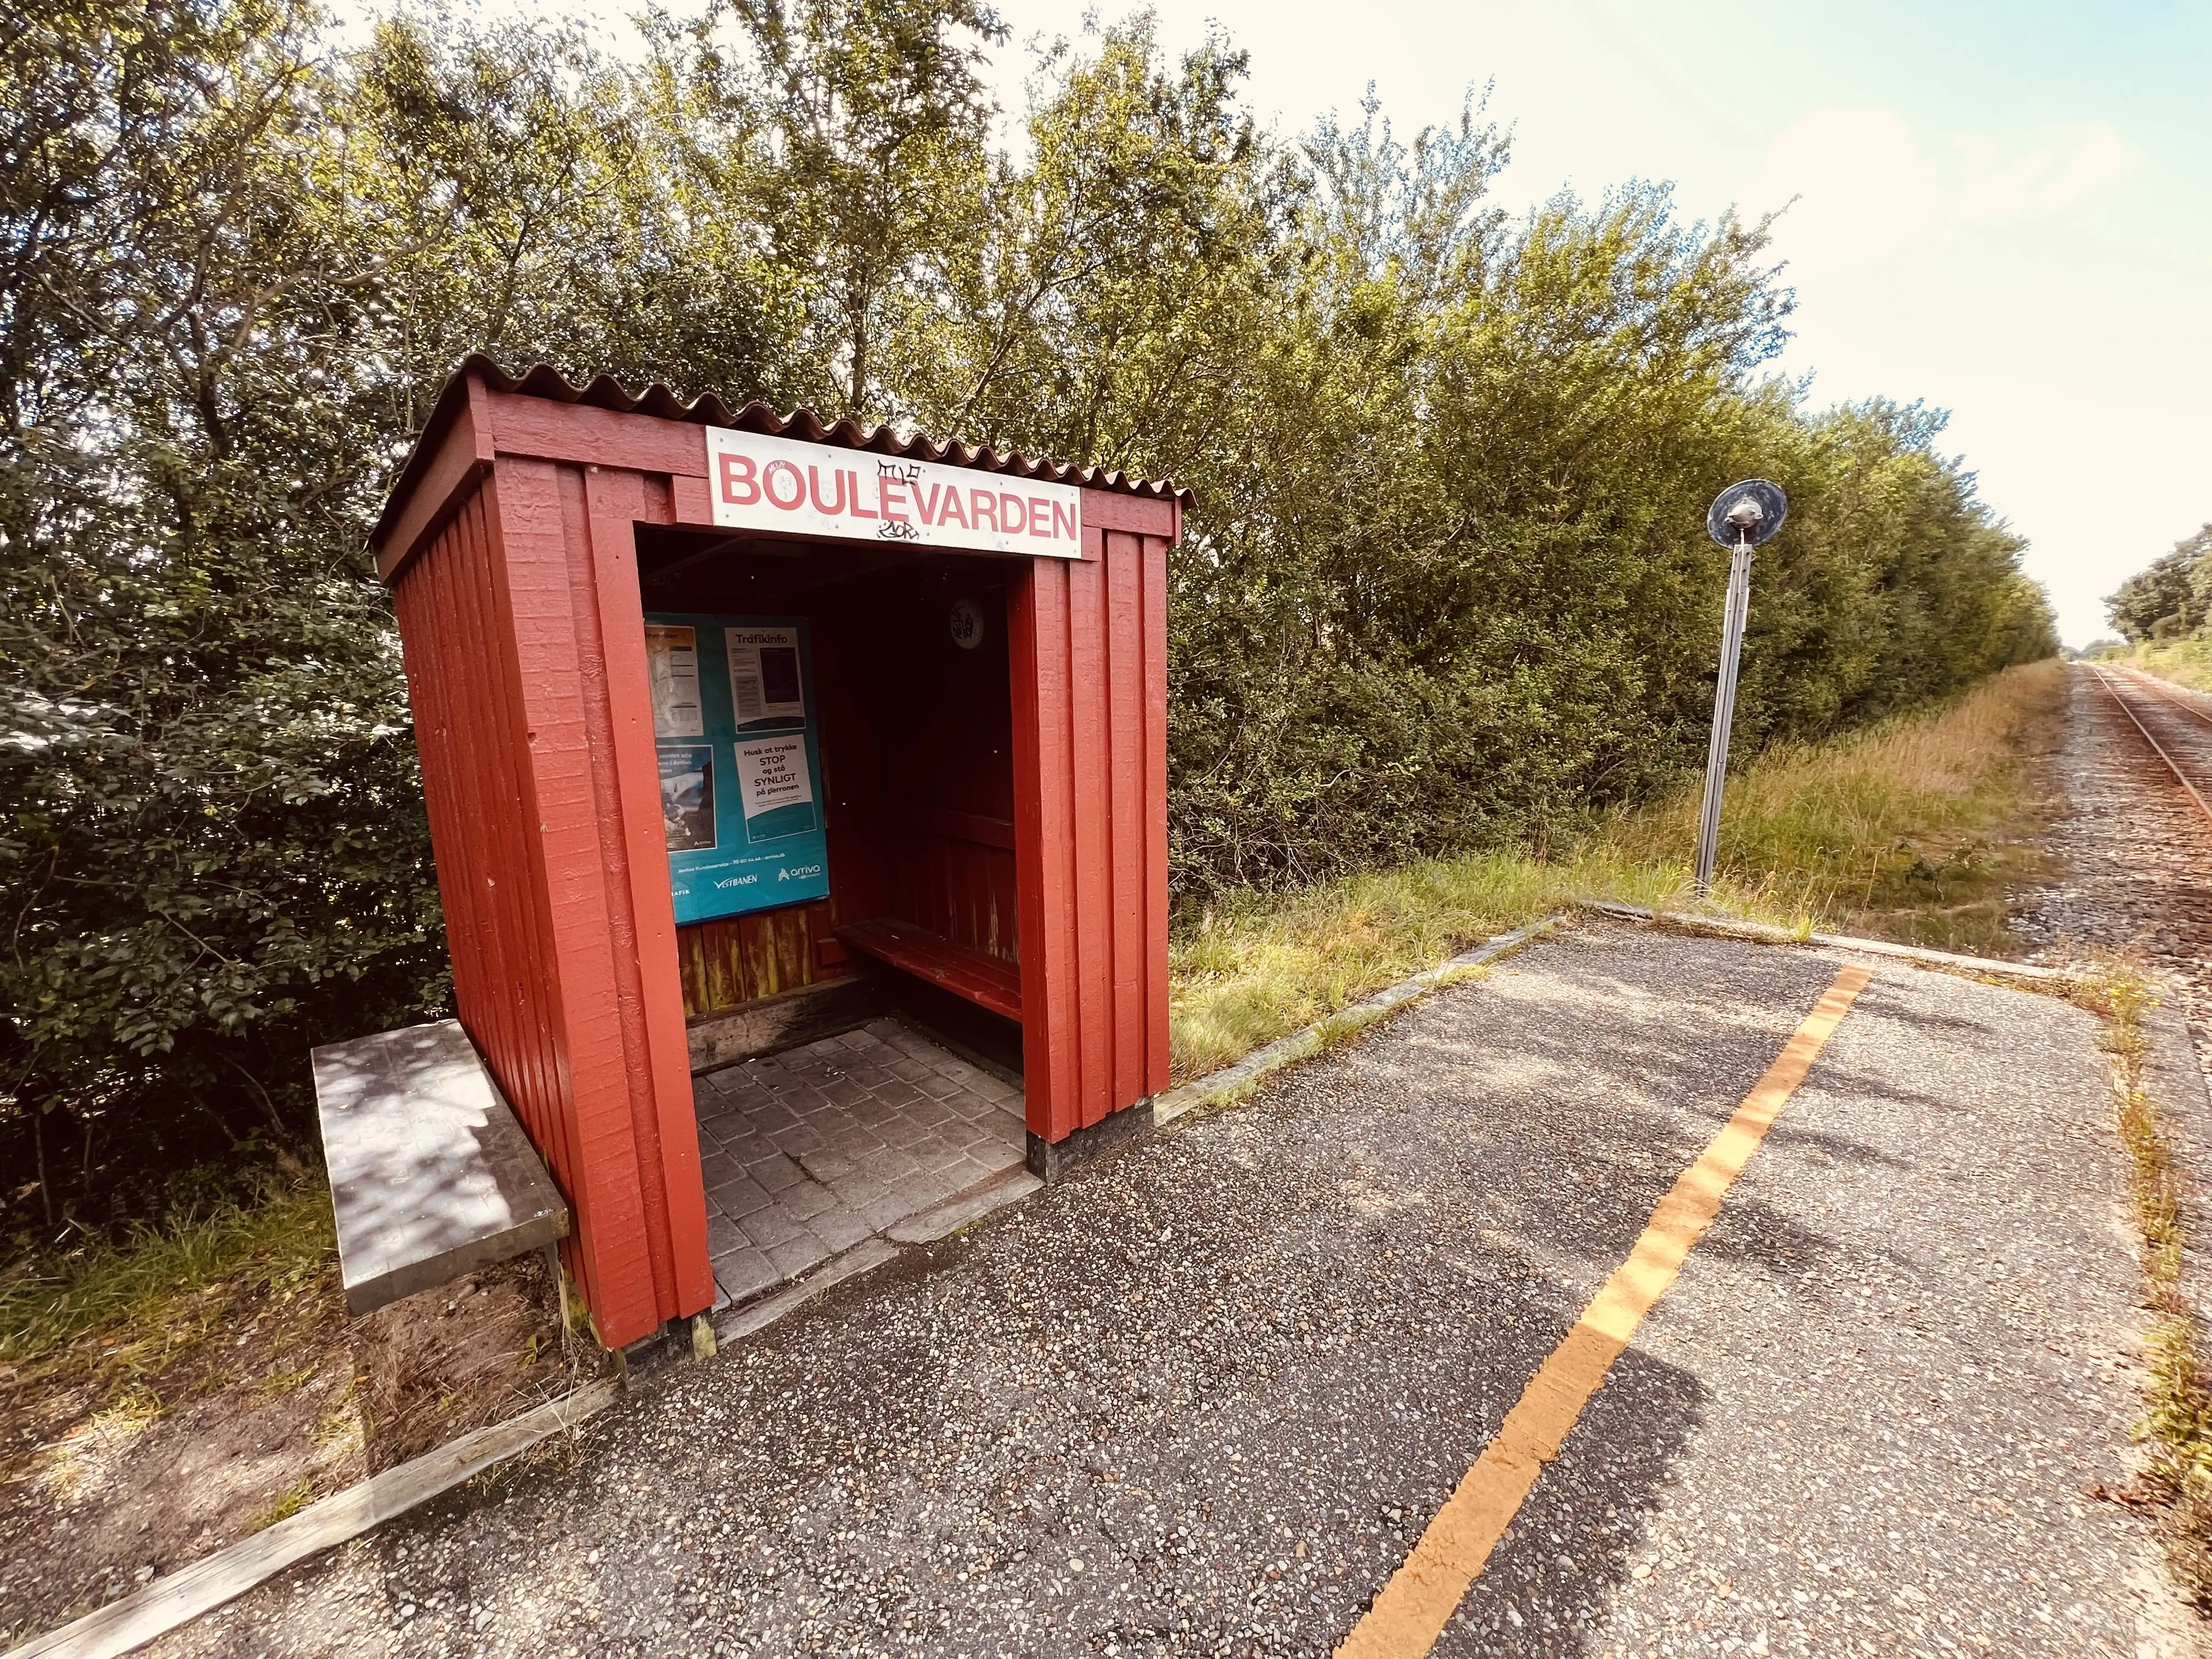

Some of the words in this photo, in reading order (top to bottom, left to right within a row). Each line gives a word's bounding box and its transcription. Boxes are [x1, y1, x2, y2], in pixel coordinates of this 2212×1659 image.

[718, 452, 1076, 541] BOULEVARDEN
[735, 634, 788, 644] Trafikinfo
[744, 748, 763, 757] Husk
[775, 744, 797, 753] trykke
[759, 755, 786, 766] STOP
[754, 773, 796, 787] SYNLIGT
[757, 788, 766, 797] på
[768, 785, 799, 795] perronen
[791, 865, 821, 876] arriva
[713, 874, 758, 889] VESTBANEN
